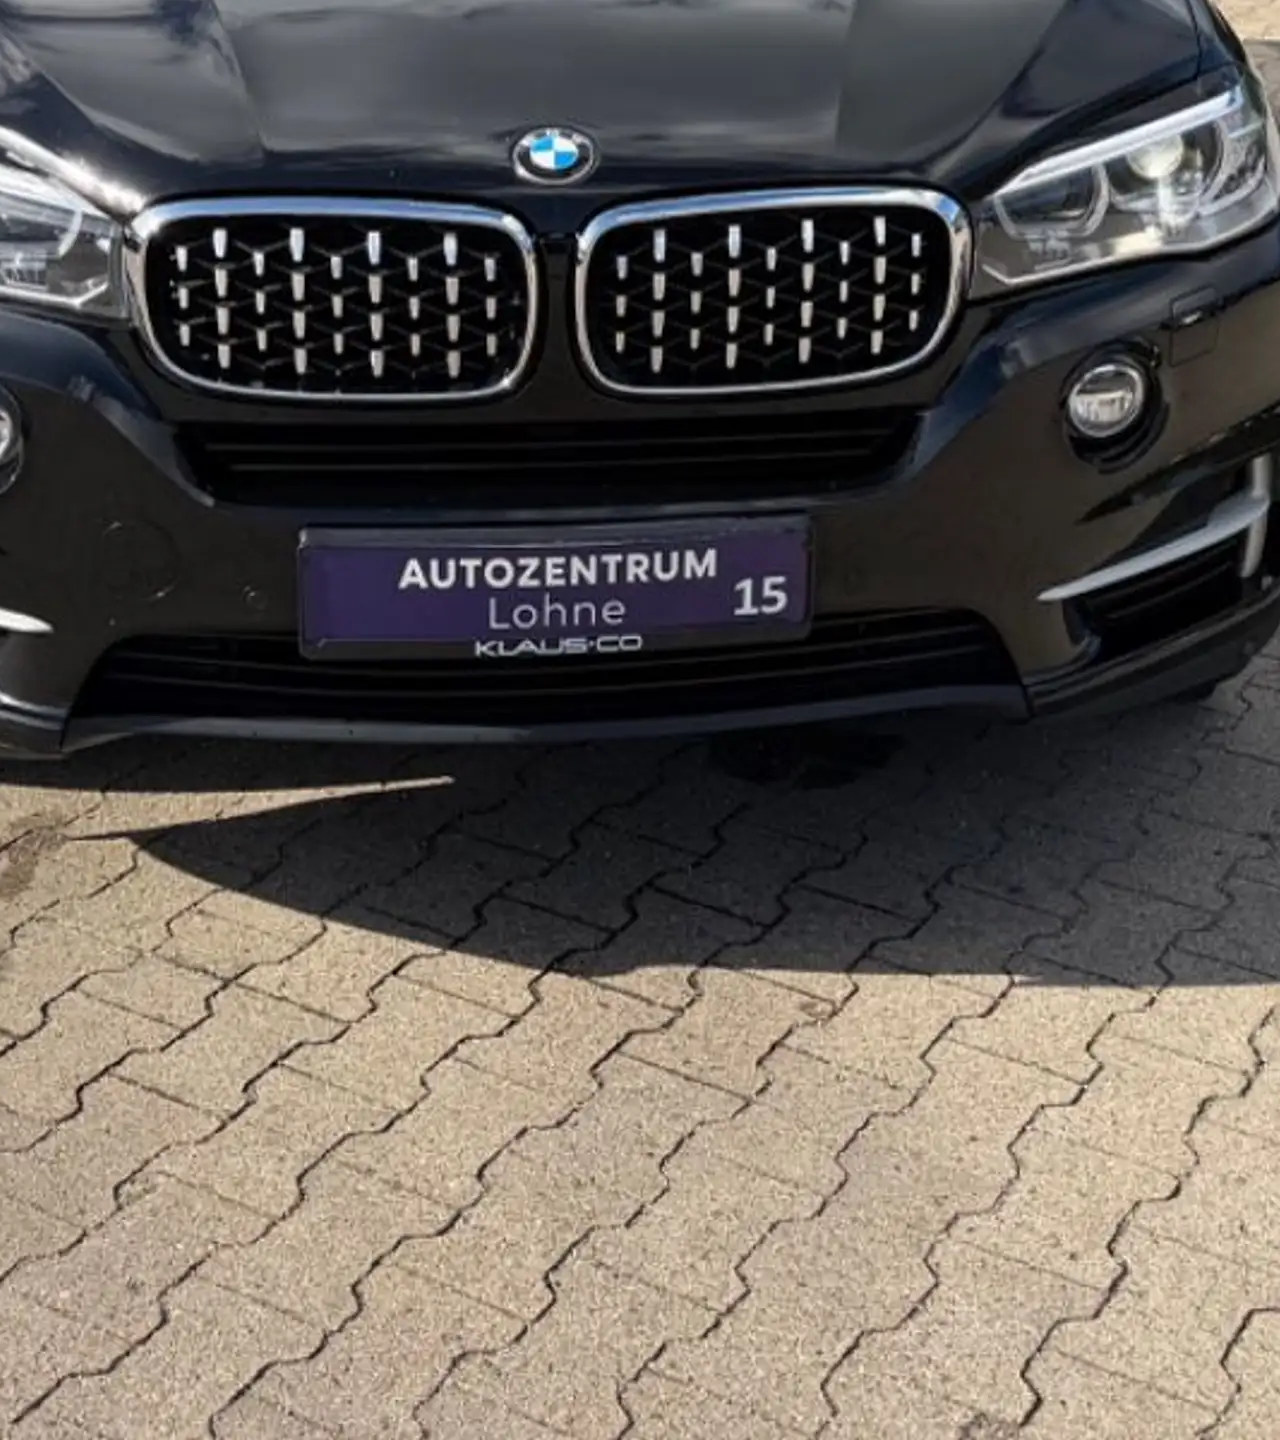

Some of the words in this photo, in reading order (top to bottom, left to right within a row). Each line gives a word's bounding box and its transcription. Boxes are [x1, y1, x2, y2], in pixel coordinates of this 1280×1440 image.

[399, 548, 717, 590] AUTOZENTRUM
[488, 592, 626, 630] Lohne
[733, 575, 788, 616] 15
